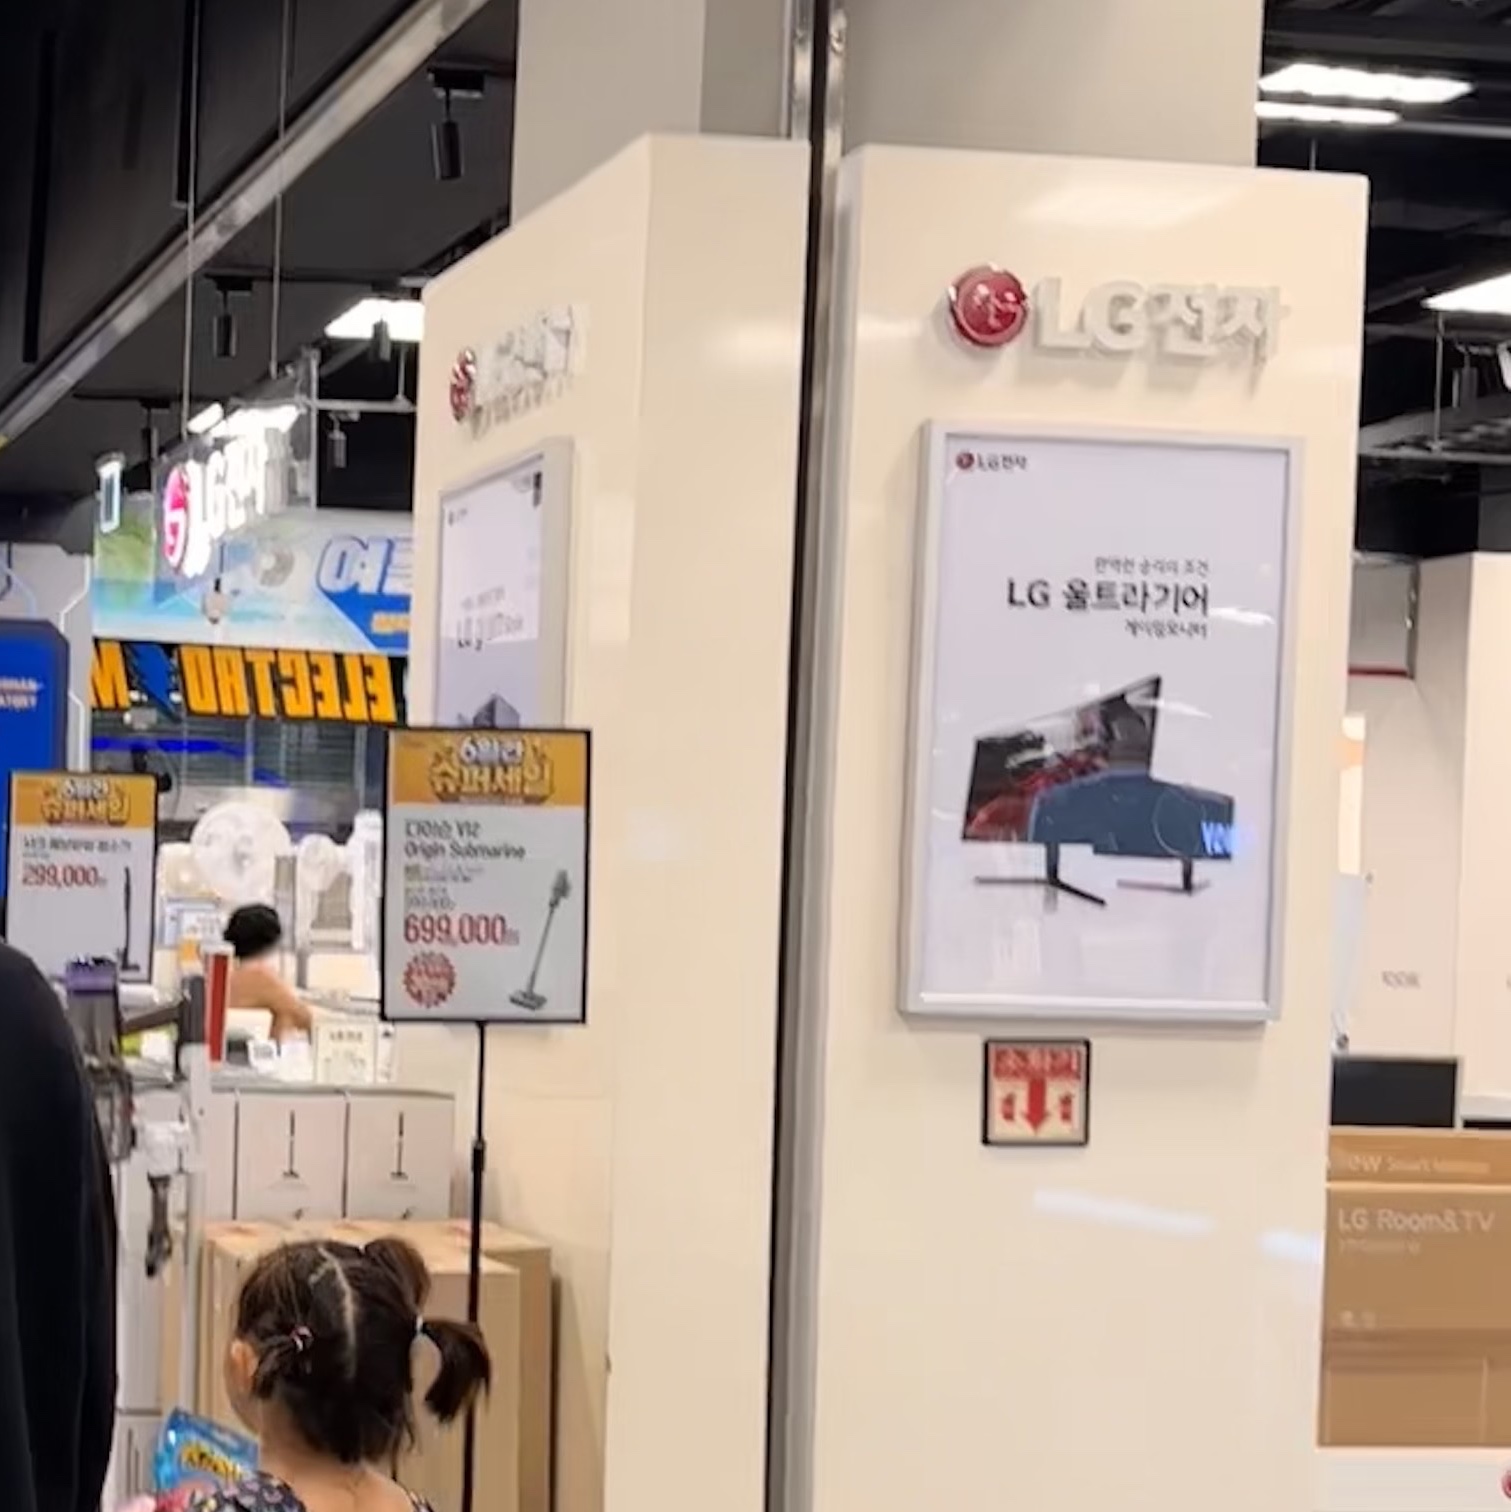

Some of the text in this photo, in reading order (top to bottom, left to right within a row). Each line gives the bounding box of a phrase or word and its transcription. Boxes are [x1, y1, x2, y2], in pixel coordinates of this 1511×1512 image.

[1035, 276, 1282, 360] LG전자
[1007, 576, 1209, 617] LG 울트라기어
[1338, 1207, 1368, 1232] LG
